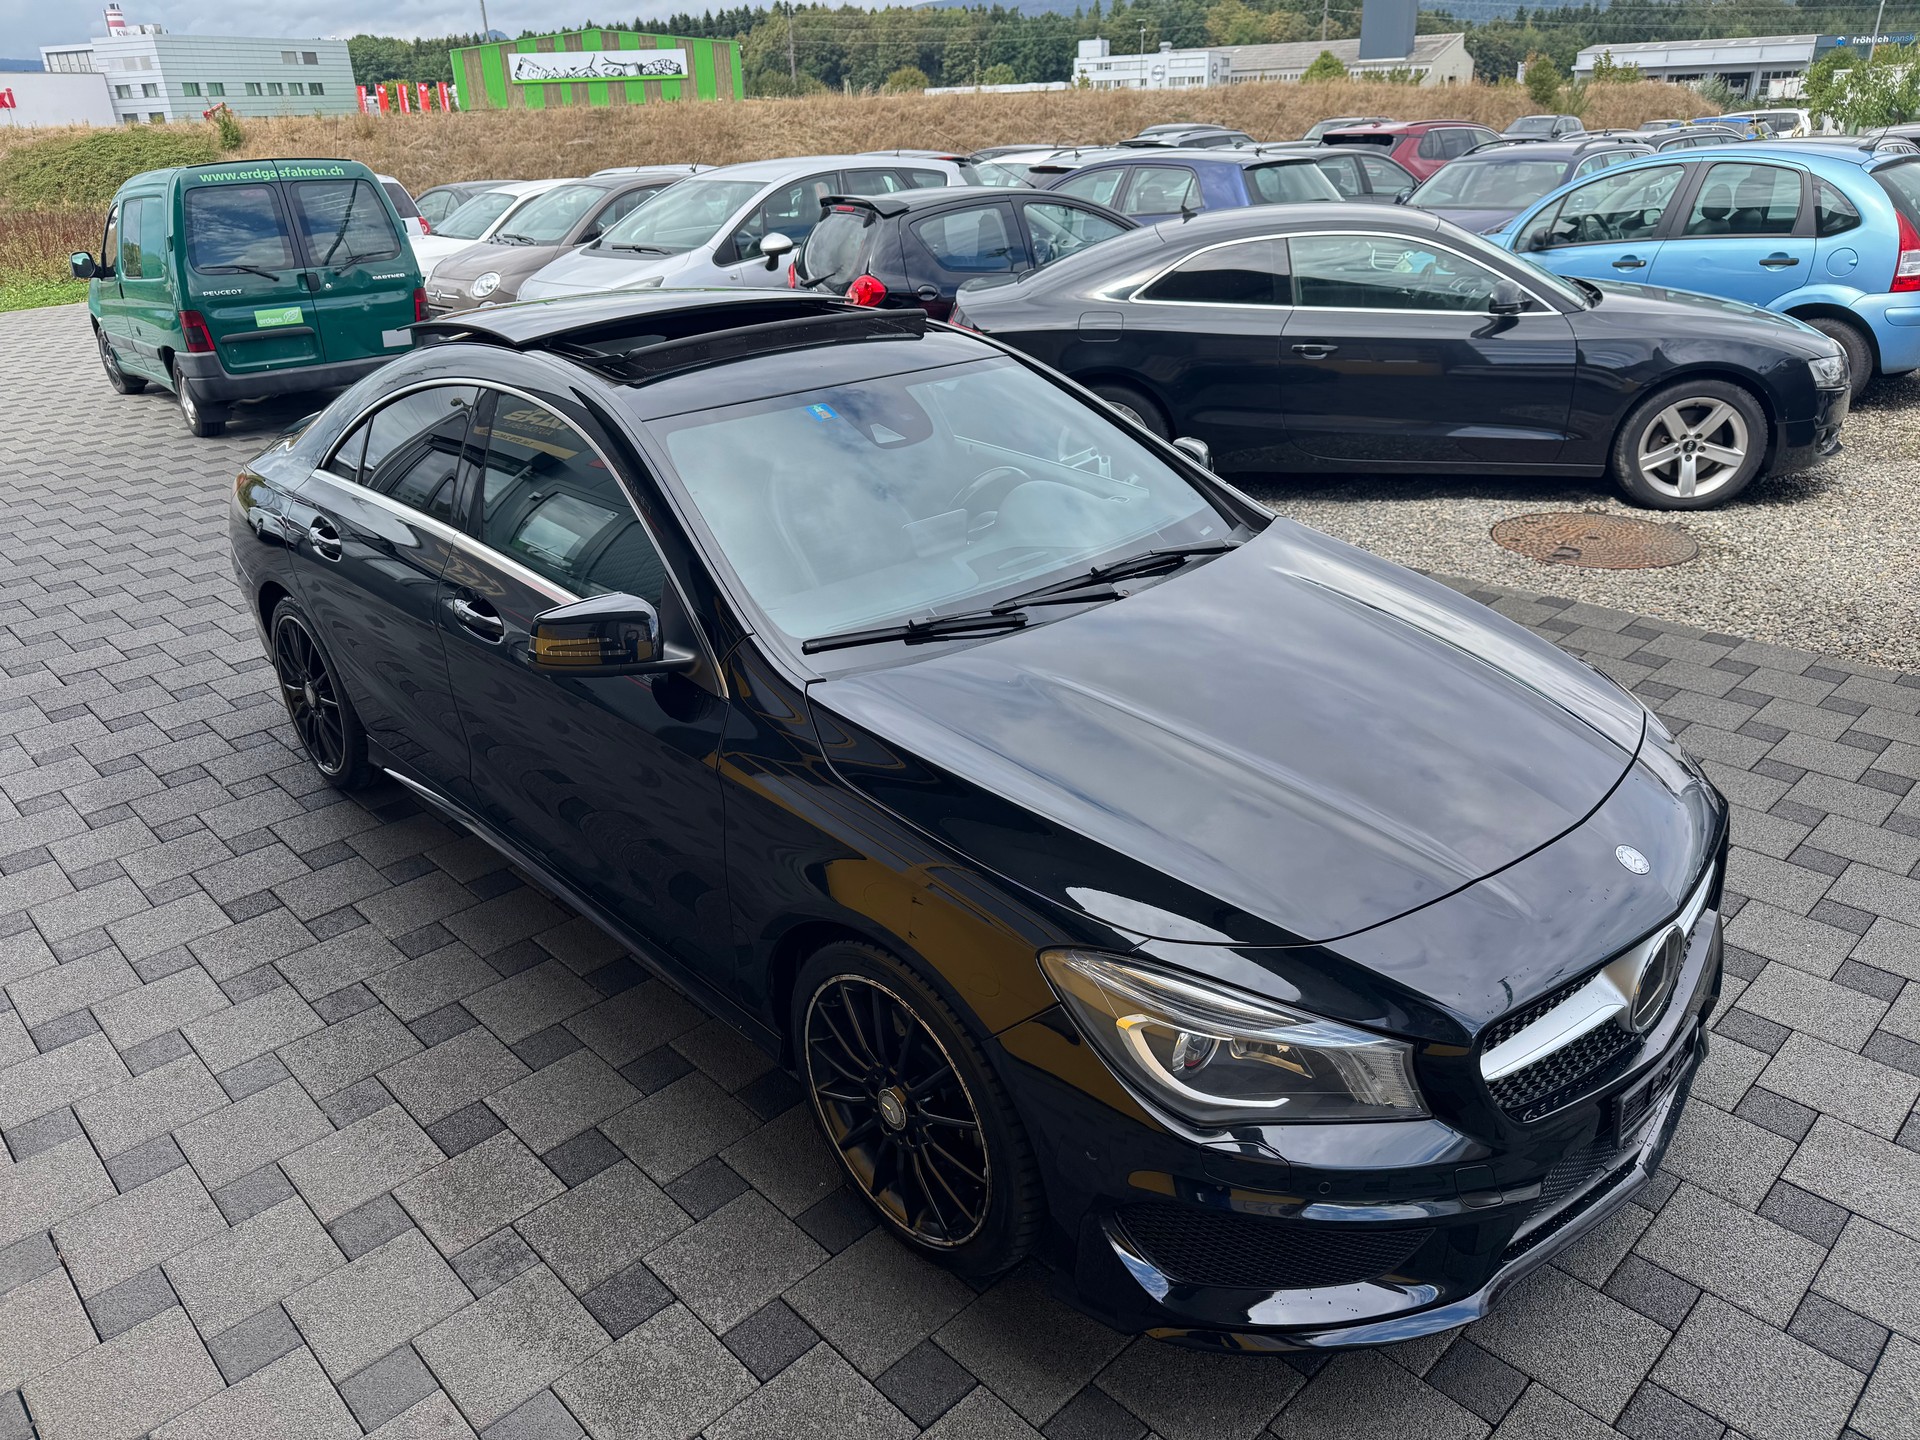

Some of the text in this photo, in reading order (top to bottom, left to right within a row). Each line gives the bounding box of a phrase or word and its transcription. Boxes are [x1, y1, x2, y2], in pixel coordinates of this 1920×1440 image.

[199, 165, 344, 182] www.erdgasfahren.ch
[203, 288, 242, 297] PEUGEOT
[258, 316, 282, 326] erdgas
